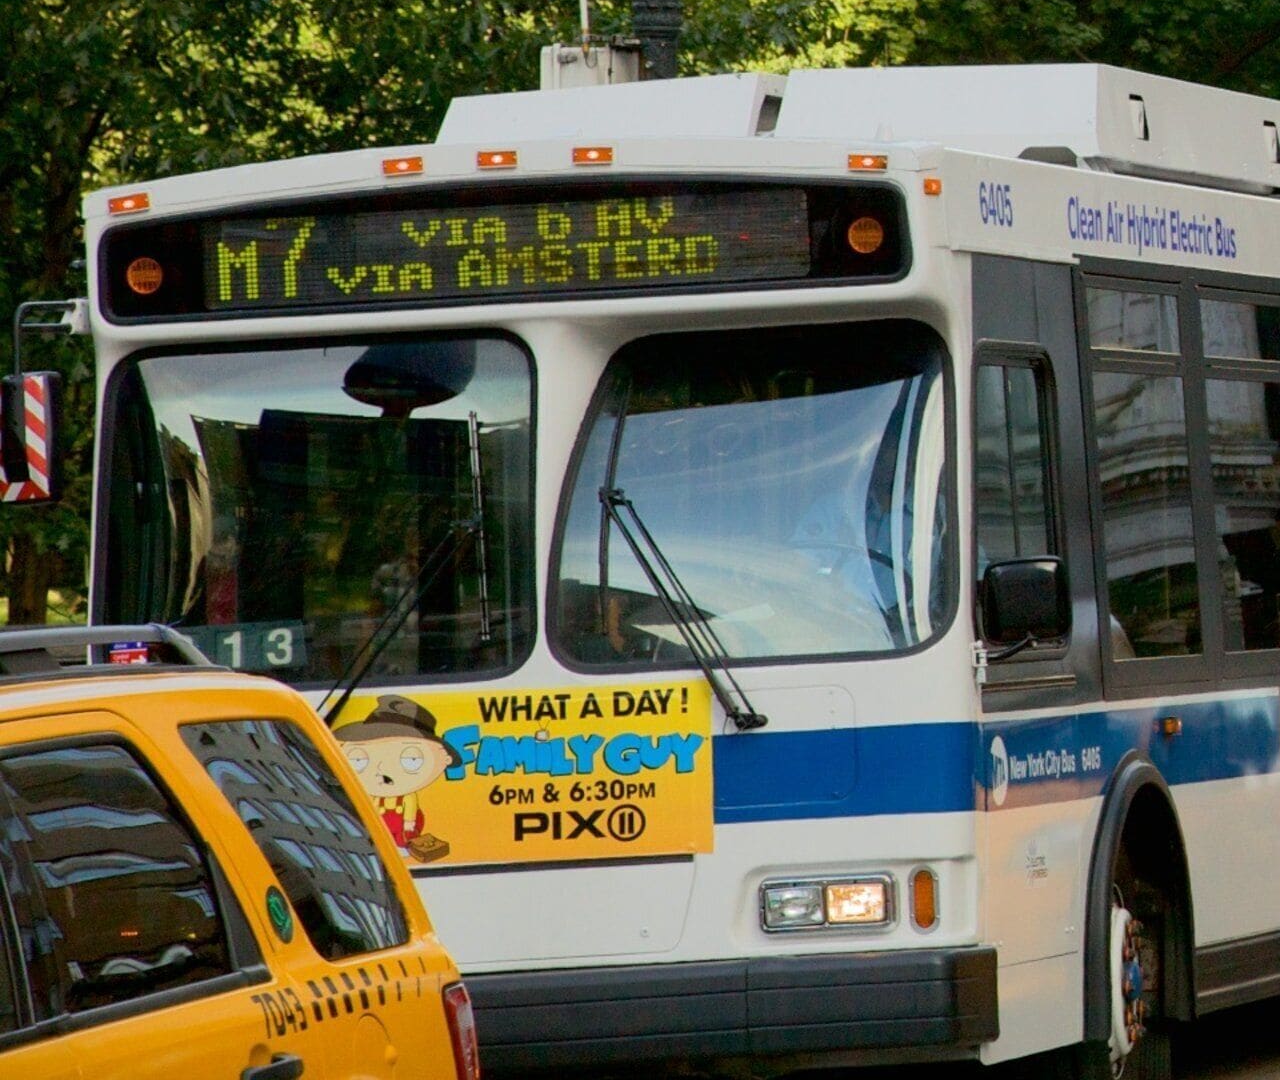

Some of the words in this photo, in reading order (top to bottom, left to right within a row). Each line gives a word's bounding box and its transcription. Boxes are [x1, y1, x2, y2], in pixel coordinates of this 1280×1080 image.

[402, 217, 506, 248] VIA
[597, 196, 676, 238] AV
[978, 181, 1014, 228] 6405
[1067, 196, 1103, 241] Clean
[1106, 201, 1123, 245] Air
[1127, 203, 1167, 256] Hybrid
[1169, 210, 1214, 257] Electric
[1215, 217, 1238, 259] Bus
[327, 263, 434, 295] VIA
[457, 235, 720, 290] AMSTERD
[478, 693, 571, 722] WHAT
[580, 693, 603, 719] A
[442, 724, 605, 780] FAMILY
[603, 733, 704, 776] GUY
[1009, 754, 1027, 780] New
[1027, 752, 1045, 778] York
[1044, 749, 1061, 779] City
[1060, 748, 1076, 773] Bus
[1081, 746, 1101, 772] 6405
[489, 784, 535, 806] 6PM
[542, 783, 560, 803] &
[569, 779, 656, 802] 6:30PM
[251, 987, 308, 1039] 7043
